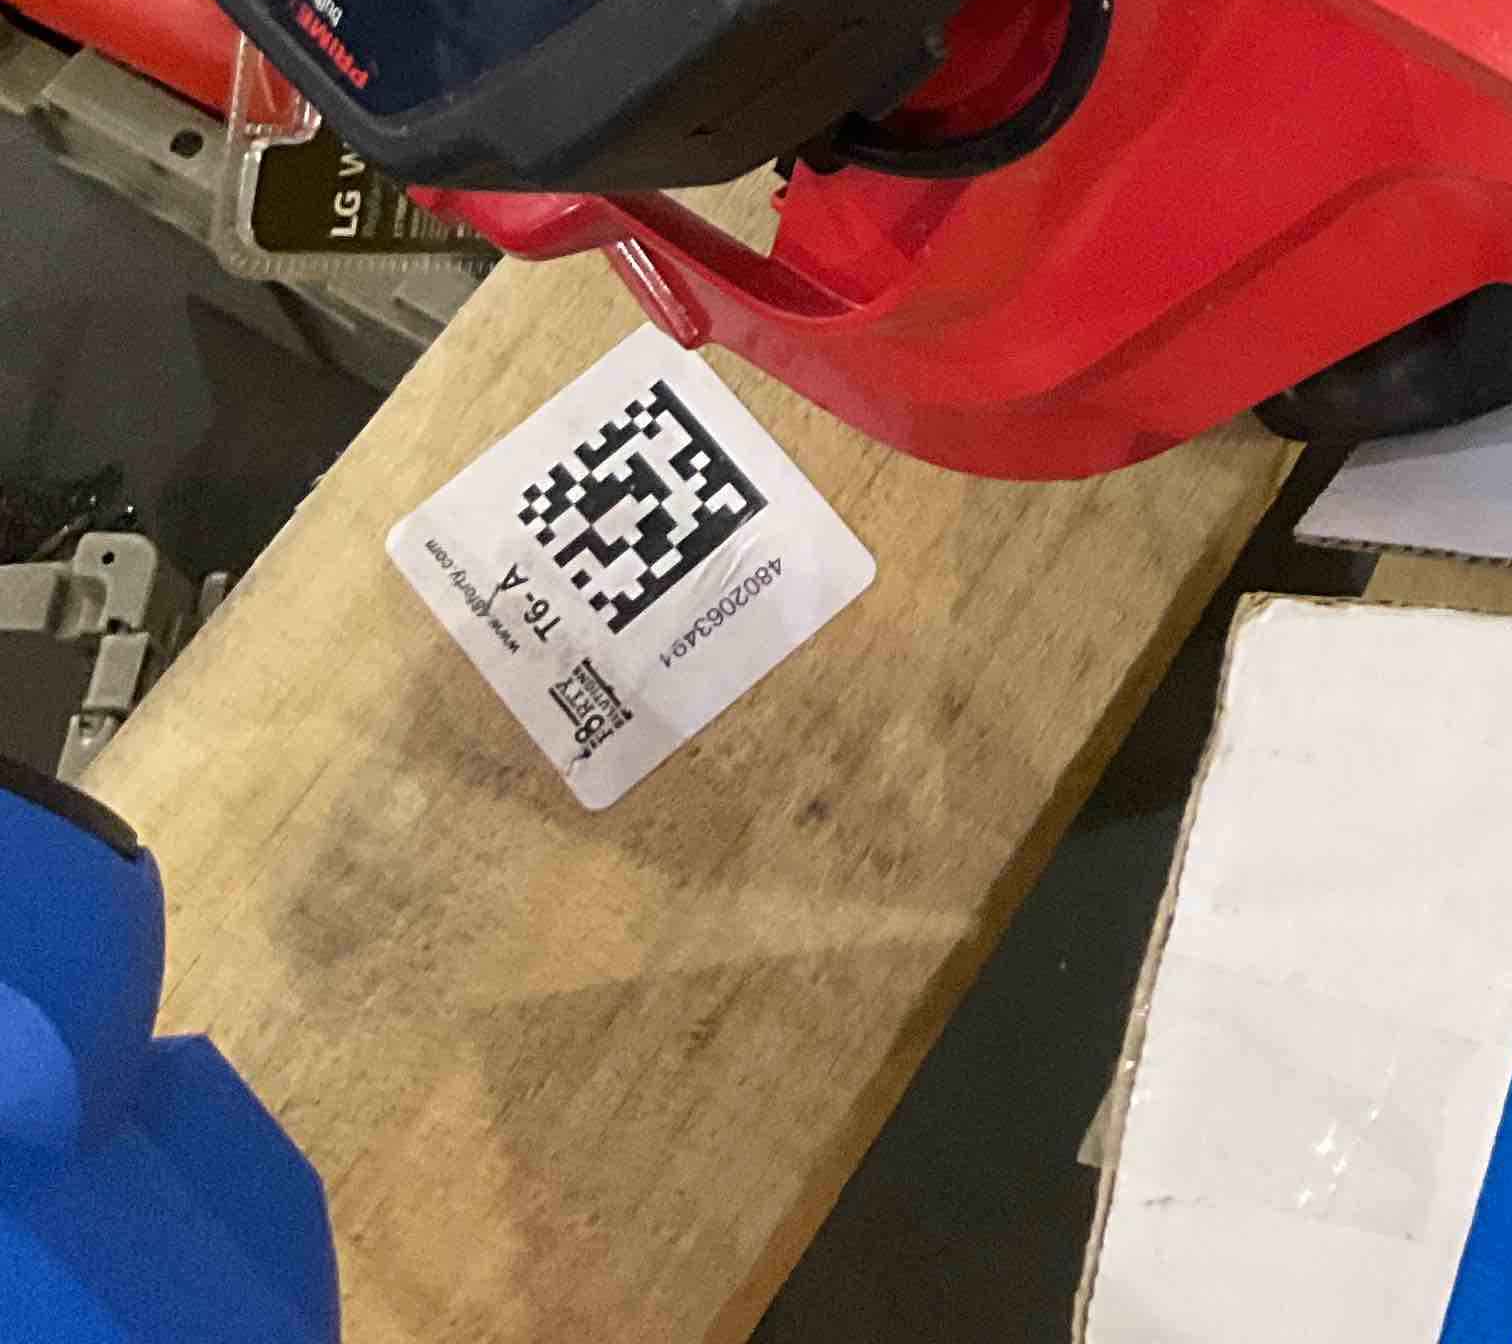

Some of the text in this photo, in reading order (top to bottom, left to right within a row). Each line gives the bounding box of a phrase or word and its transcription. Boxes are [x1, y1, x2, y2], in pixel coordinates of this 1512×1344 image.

[329, 190, 361, 238] LG
[495, 562, 529, 592] A
[659, 557, 782, 669] 4802063491
